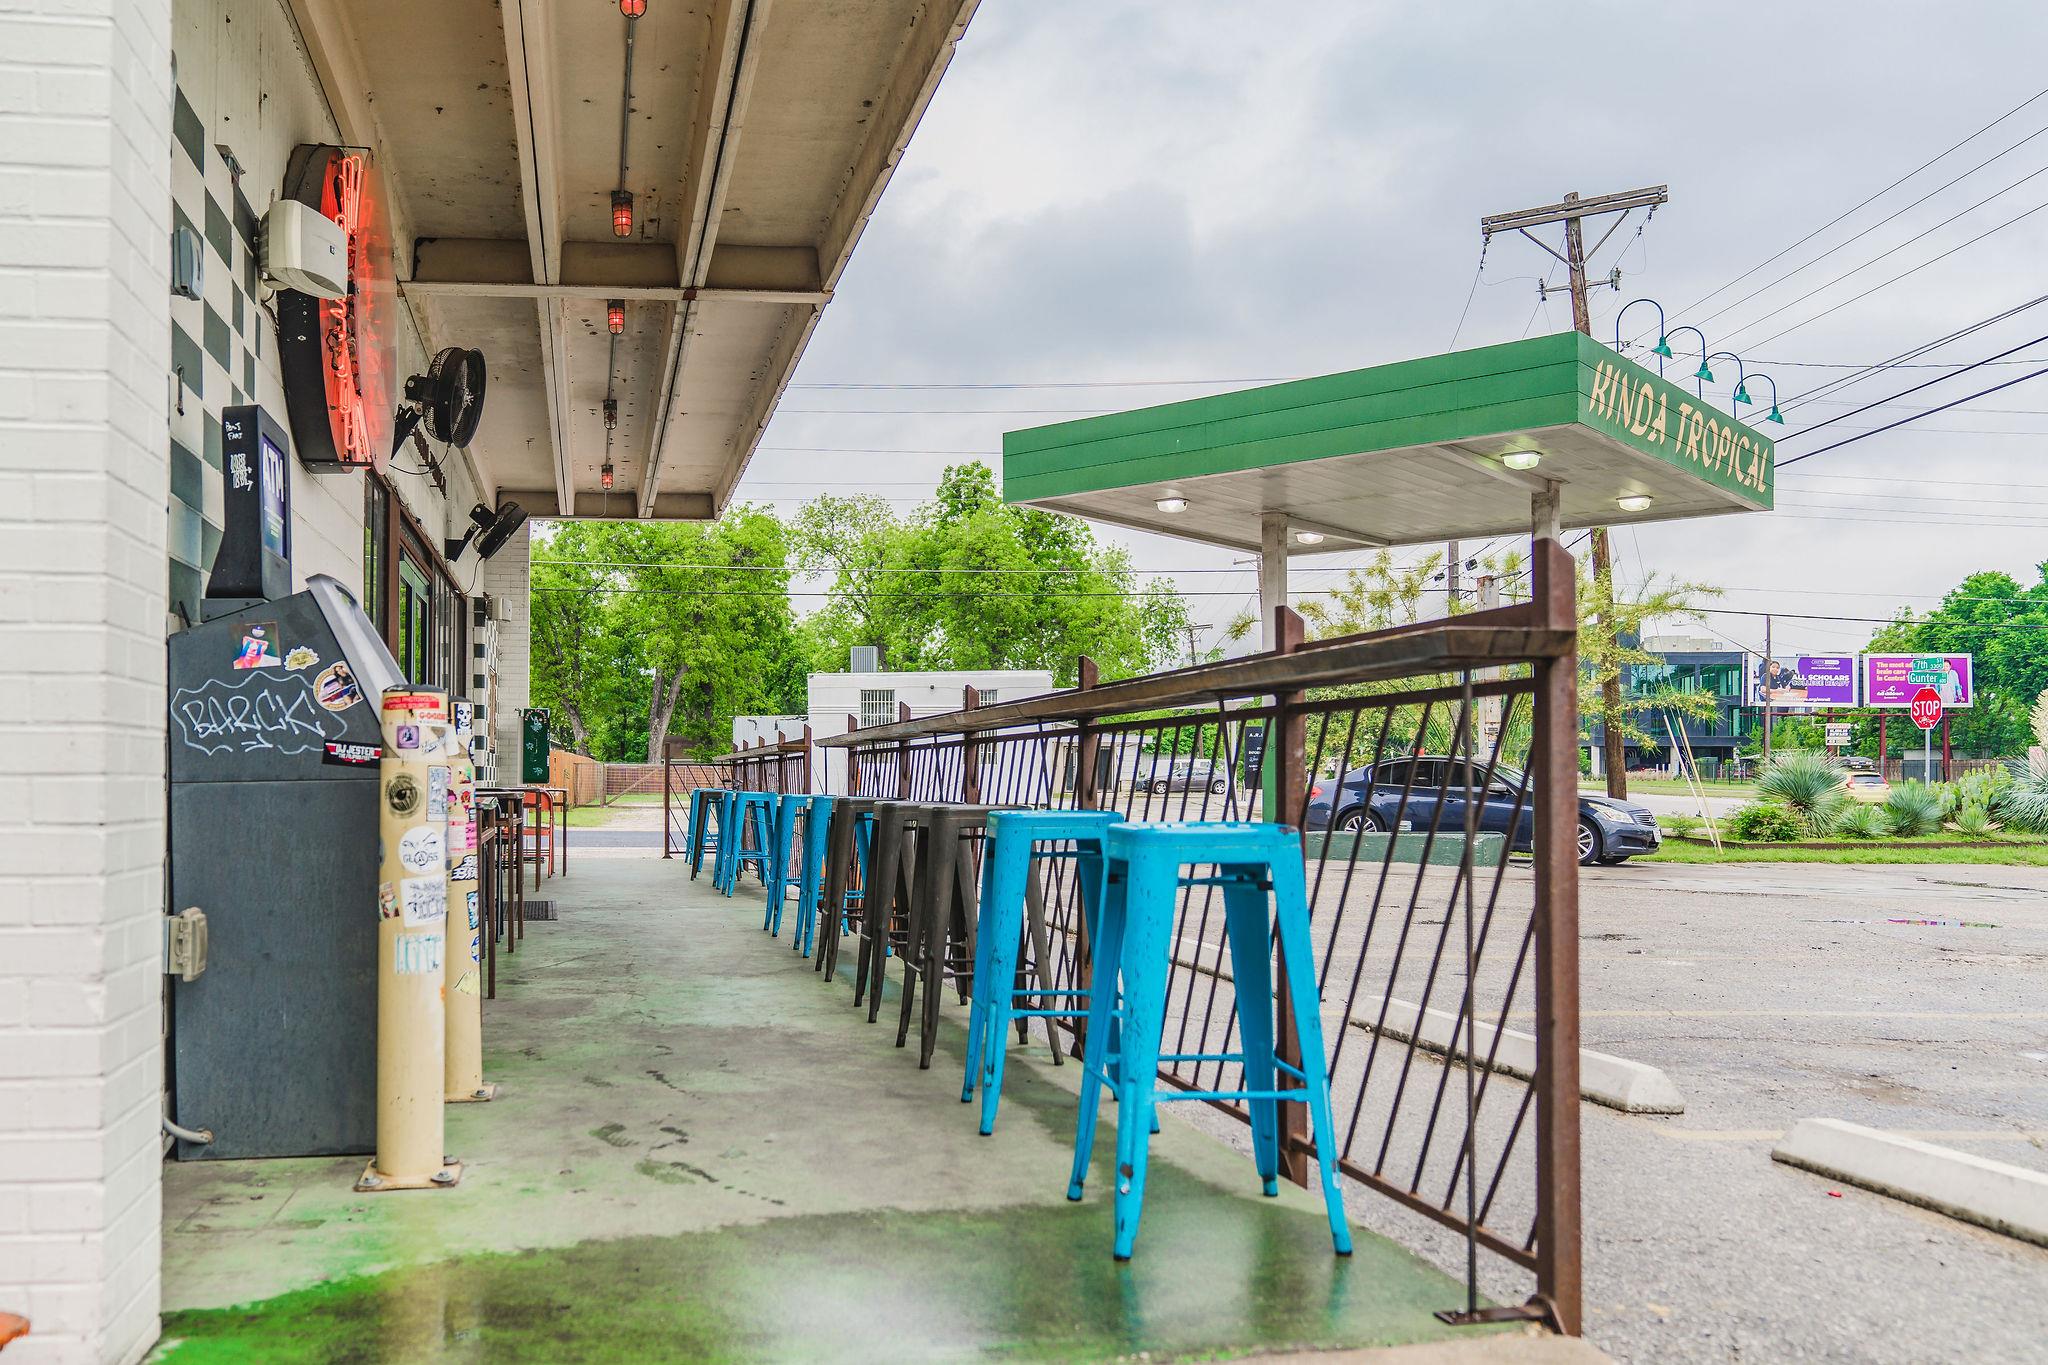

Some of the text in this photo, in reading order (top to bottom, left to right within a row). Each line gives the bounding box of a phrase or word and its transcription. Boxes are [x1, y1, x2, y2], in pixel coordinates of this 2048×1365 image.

[1589, 360, 1769, 493] KINDA TROPICAL
[262, 442, 285, 503] ATM
[1917, 661, 1928, 669] 7th
[1910, 673, 1938, 683] Gunter
[1913, 701, 1940, 716] STOP
[335, 743, 375, 756] DJ JESTER
